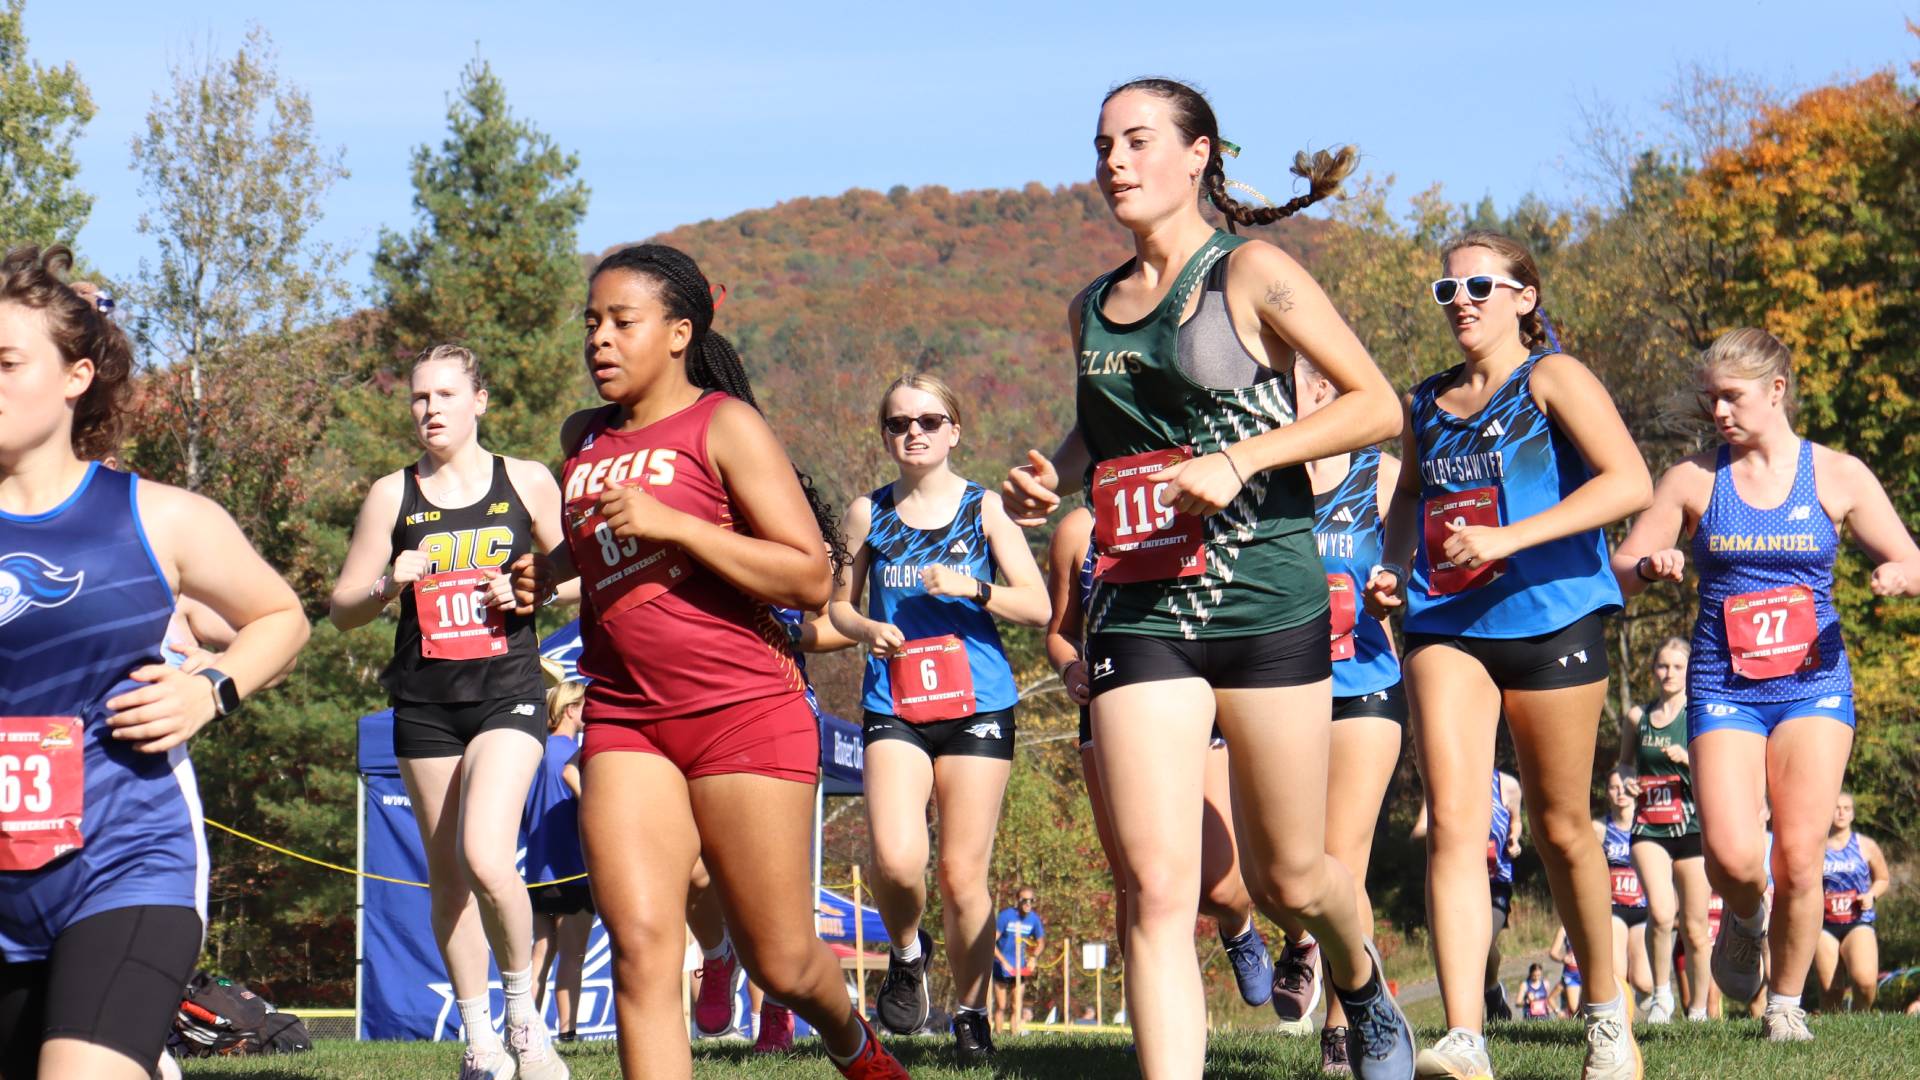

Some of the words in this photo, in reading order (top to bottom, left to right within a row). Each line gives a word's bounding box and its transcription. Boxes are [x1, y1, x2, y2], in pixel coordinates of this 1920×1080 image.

[1079, 350, 1142, 377] ELMS
[564, 447, 678, 504] REGIS
[1117, 467, 1138, 478] CADET
[1139, 463, 1163, 474] INVITE
[1421, 450, 1504, 486] COLBY-SAWYER
[1114, 482, 1175, 537] 119
[417, 525, 515, 575] AIC
[1141, 534, 1188, 549] UNIVERSITY
[1314, 533, 1353, 558] WYER
[1708, 534, 1821, 552] EMMANUEL
[668, 565, 682, 579] 85
[883, 564, 971, 588] COLBY-ER
[435, 590, 489, 629] 106
[1752, 609, 1788, 647] 27
[919, 658, 938, 691] 6
[1641, 735, 1672, 748] ELMS
[0, 754, 52, 814] 63
[1646, 786, 1672, 806] 120
[1615, 875, 1638, 893] 140
[1830, 898, 1852, 913] 142
